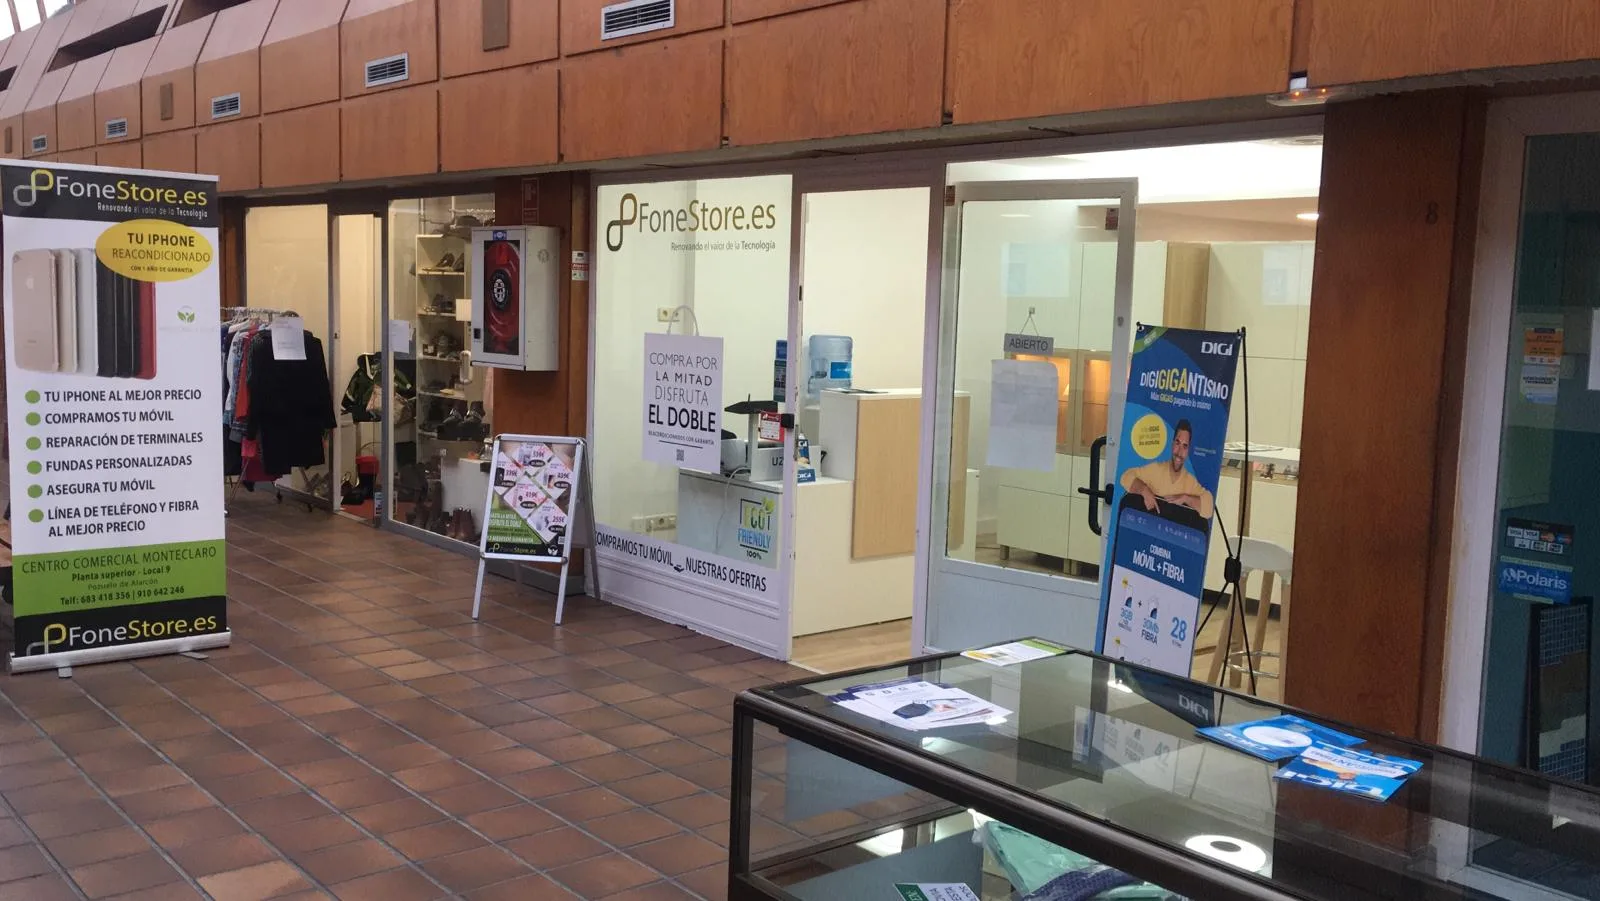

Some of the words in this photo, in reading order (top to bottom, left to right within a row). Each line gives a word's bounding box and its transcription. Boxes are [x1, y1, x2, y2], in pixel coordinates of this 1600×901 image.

[56, 175, 208, 206] FoneStore.es
[97, 202, 132, 213] Renovando
[142, 206, 157, 215] valor
[639, 199, 776, 233] FoneStore.es
[127, 232, 144, 245] TU
[148, 233, 195, 247] IPHONE
[671, 241, 703, 251] Renovando
[726, 240, 734, 250] de
[112, 247, 211, 263] REACONDICIONADO
[1008, 338, 1049, 351] ABIERTO
[1200, 341, 1234, 356] DIGI
[649, 352, 694, 369] COMPRA
[696, 355, 718, 371] POR
[655, 370, 669, 382] LA
[674, 373, 713, 387] MITAD
[1139, 367, 1230, 400] DIGIGIGANTISMO
[44, 391, 60, 403] TU
[63, 390, 106, 402] IPHONE
[108, 390, 123, 401] AL
[125, 390, 162, 402] MEJOR
[164, 388, 202, 400] PRECIO
[654, 385, 709, 406] DISFRUTA
[45, 411, 120, 424] COMPRAMOS
[122, 411, 137, 422] TU
[139, 408, 174, 422] MÓVIL
[648, 403, 664, 425] EL
[667, 406, 716, 433] DOBLE
[46, 433, 118, 448] REPARACIÓN
[121, 434, 135, 445] DE
[137, 431, 204, 445] TERMINALES
[46, 458, 93, 472] FUNDAS
[95, 455, 193, 470] PERSONALIZADAS
[46, 482, 100, 496] ASEGURA
[102, 481, 118, 493] TU
[120, 478, 156, 491] MÓVIL
[48, 504, 81, 520] LÍNEA
[83, 506, 98, 517] DE
[101, 502, 157, 516] TELÉFONO
[159, 501, 167, 512] Y
[168, 500, 199, 512] FIBRA
[48, 526, 63, 537] AL
[65, 522, 104, 536] MEJOR
[106, 520, 146, 533] PRECIO
[737, 527, 772, 549] FRIENDLY
[22, 558, 70, 574] CENTRO
[73, 553, 139, 569] COMERCIAL
[142, 546, 217, 564] MONTECLARO
[638, 543, 649, 560] TU
[649, 547, 674, 567] MÓVIL
[746, 550, 762, 560] 100%
[1149, 543, 1171, 561] COMBINA
[71, 572, 99, 582] Planta
[101, 568, 136, 580] superior
[143, 566, 164, 576] Local
[165, 565, 171, 574] 9
[685, 556, 728, 584] NUESTRAS
[728, 569, 767, 592] OFERTAS
[1132, 549, 1156, 573] MÓVIL
[1162, 563, 1185, 584] FIBRA
[88, 581, 118, 591] Pozuelo
[120, 580, 129, 588] de
[131, 578, 158, 588] Alarcón
[1516, 569, 1568, 590] Polaris
[80, 594, 96, 604] 683
[115, 591, 131, 600] 356
[137, 589, 152, 598] 910
[153, 587, 168, 597] 642
[170, 585, 185, 595] 246
[69, 615, 217, 647] FoneStore.es
[1141, 629, 1158, 645] FIBRA
[1170, 616, 1188, 642] 28
